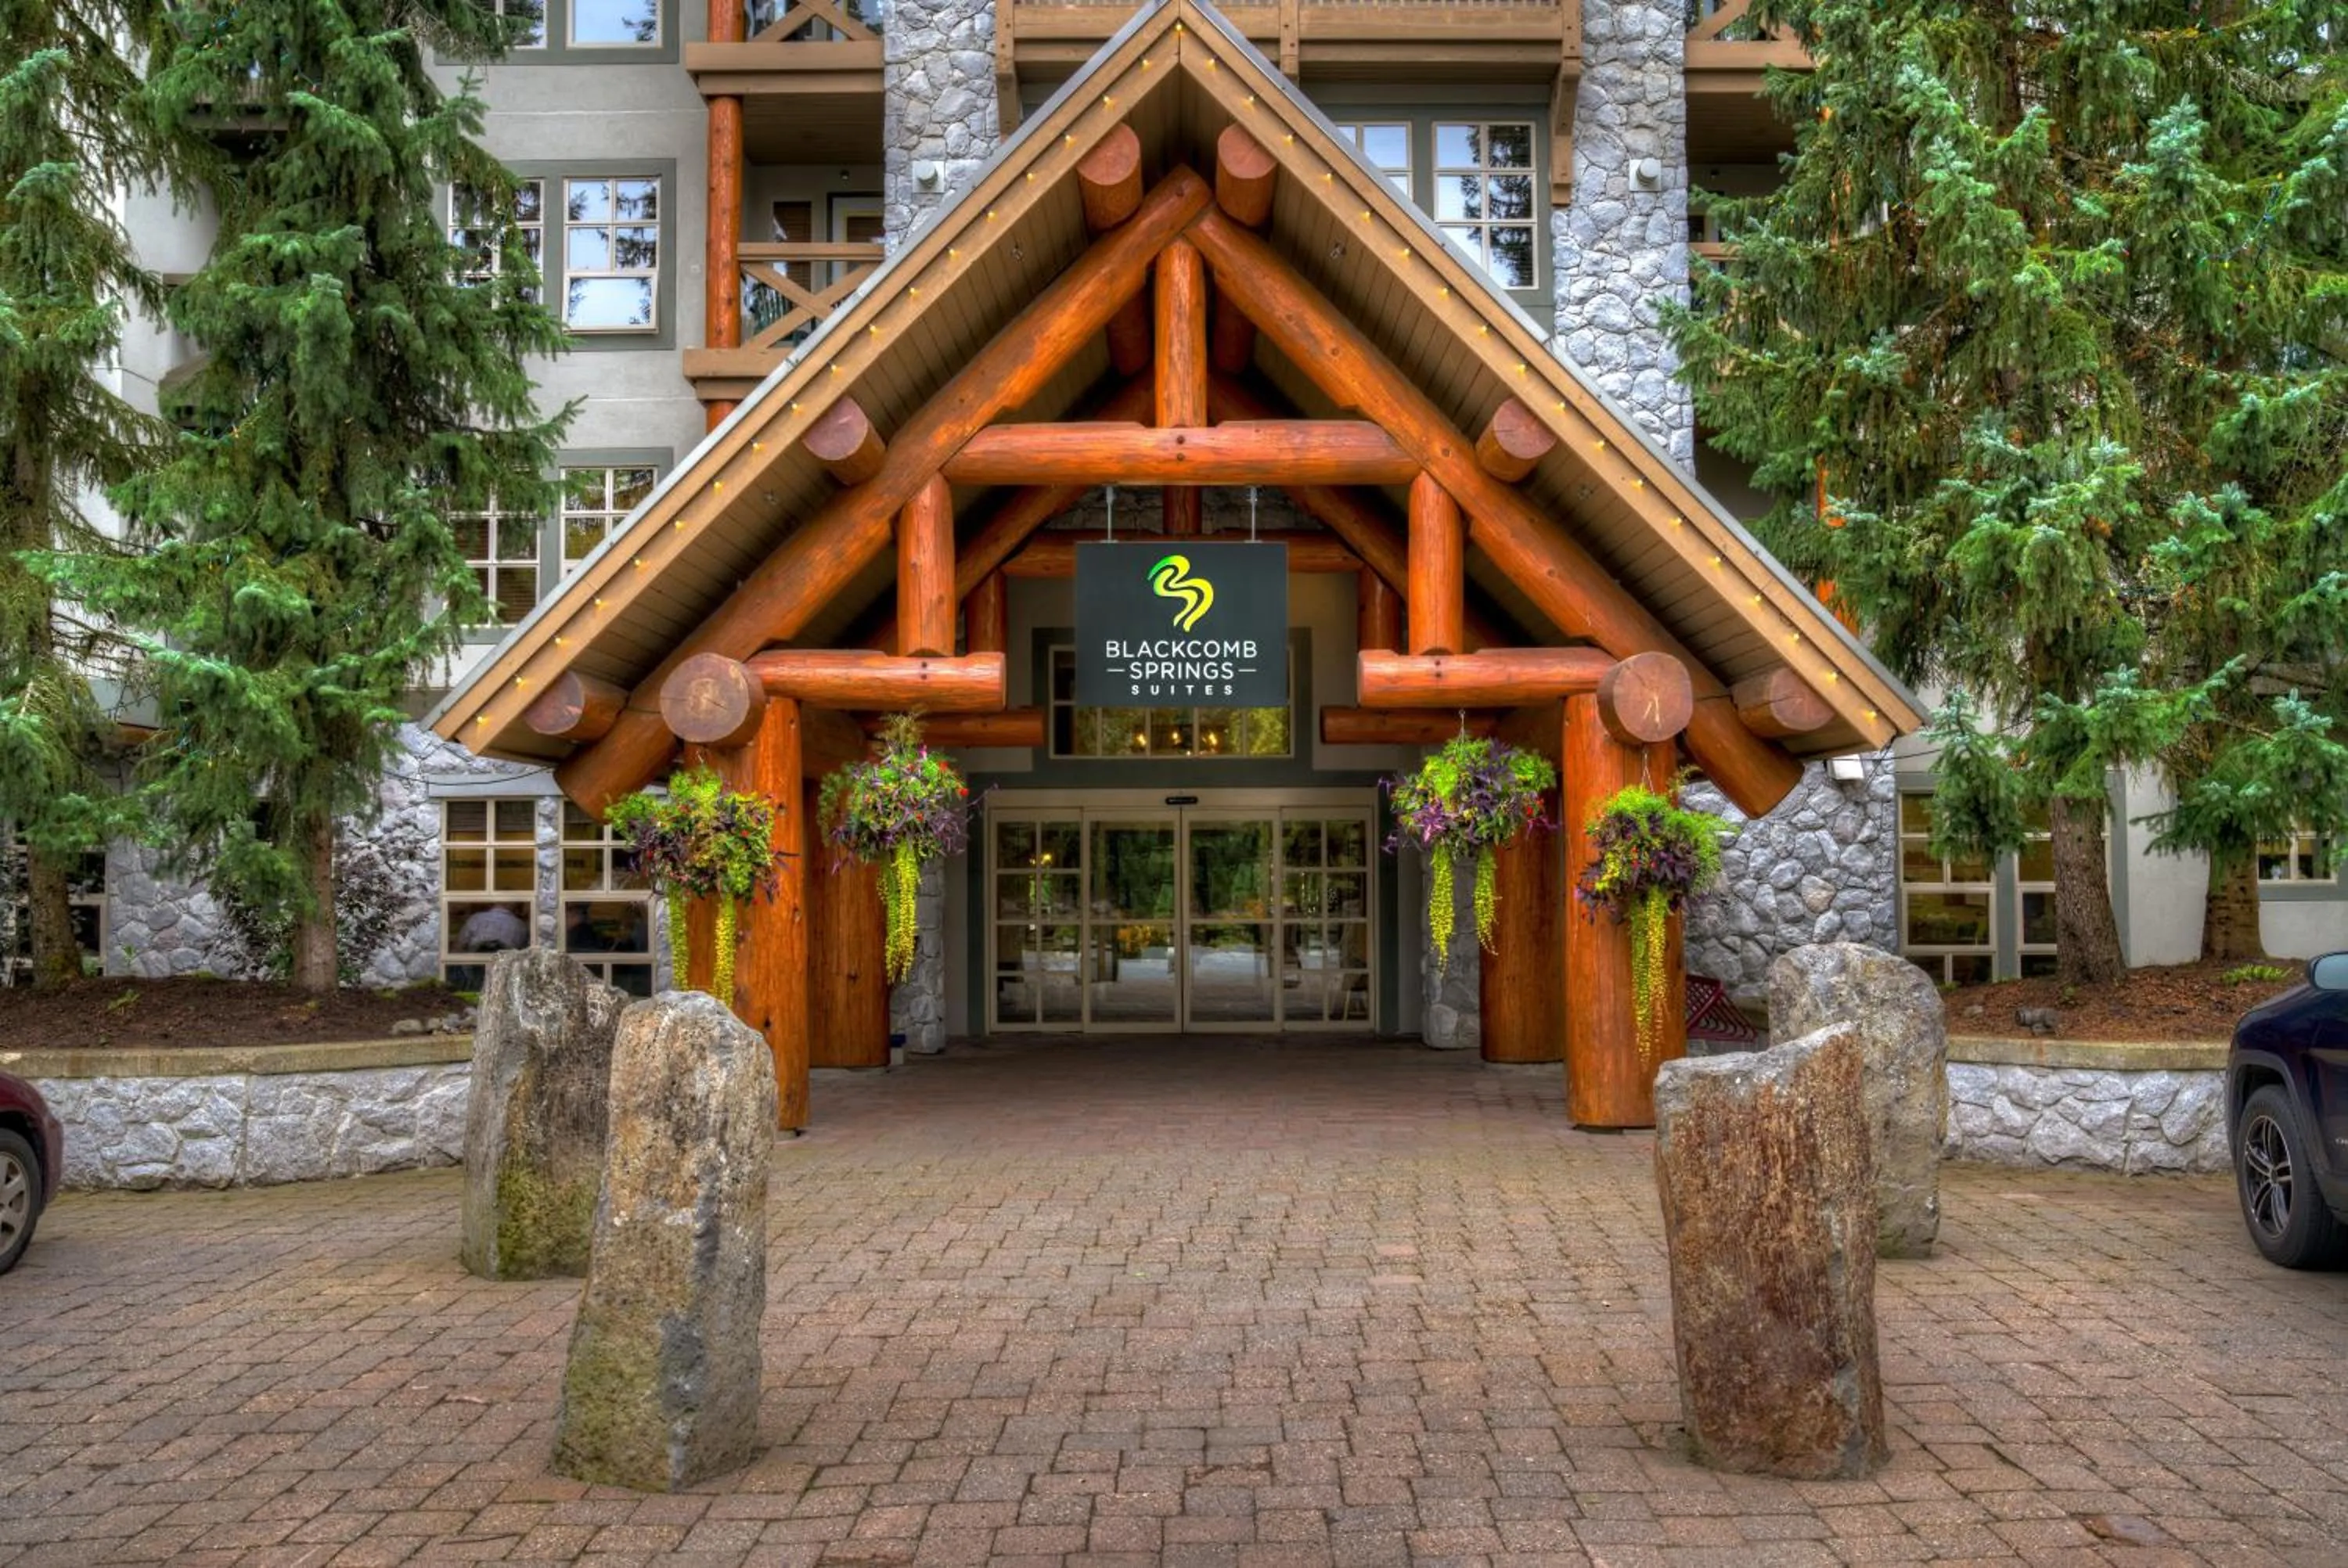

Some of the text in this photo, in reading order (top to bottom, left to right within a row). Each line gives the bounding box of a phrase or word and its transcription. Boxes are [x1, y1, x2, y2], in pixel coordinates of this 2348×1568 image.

[1106, 641, 1258, 658] BLACKCOMB
[1129, 661, 1234, 680] SPRINGS
[1131, 685, 1233, 696] SUITES
